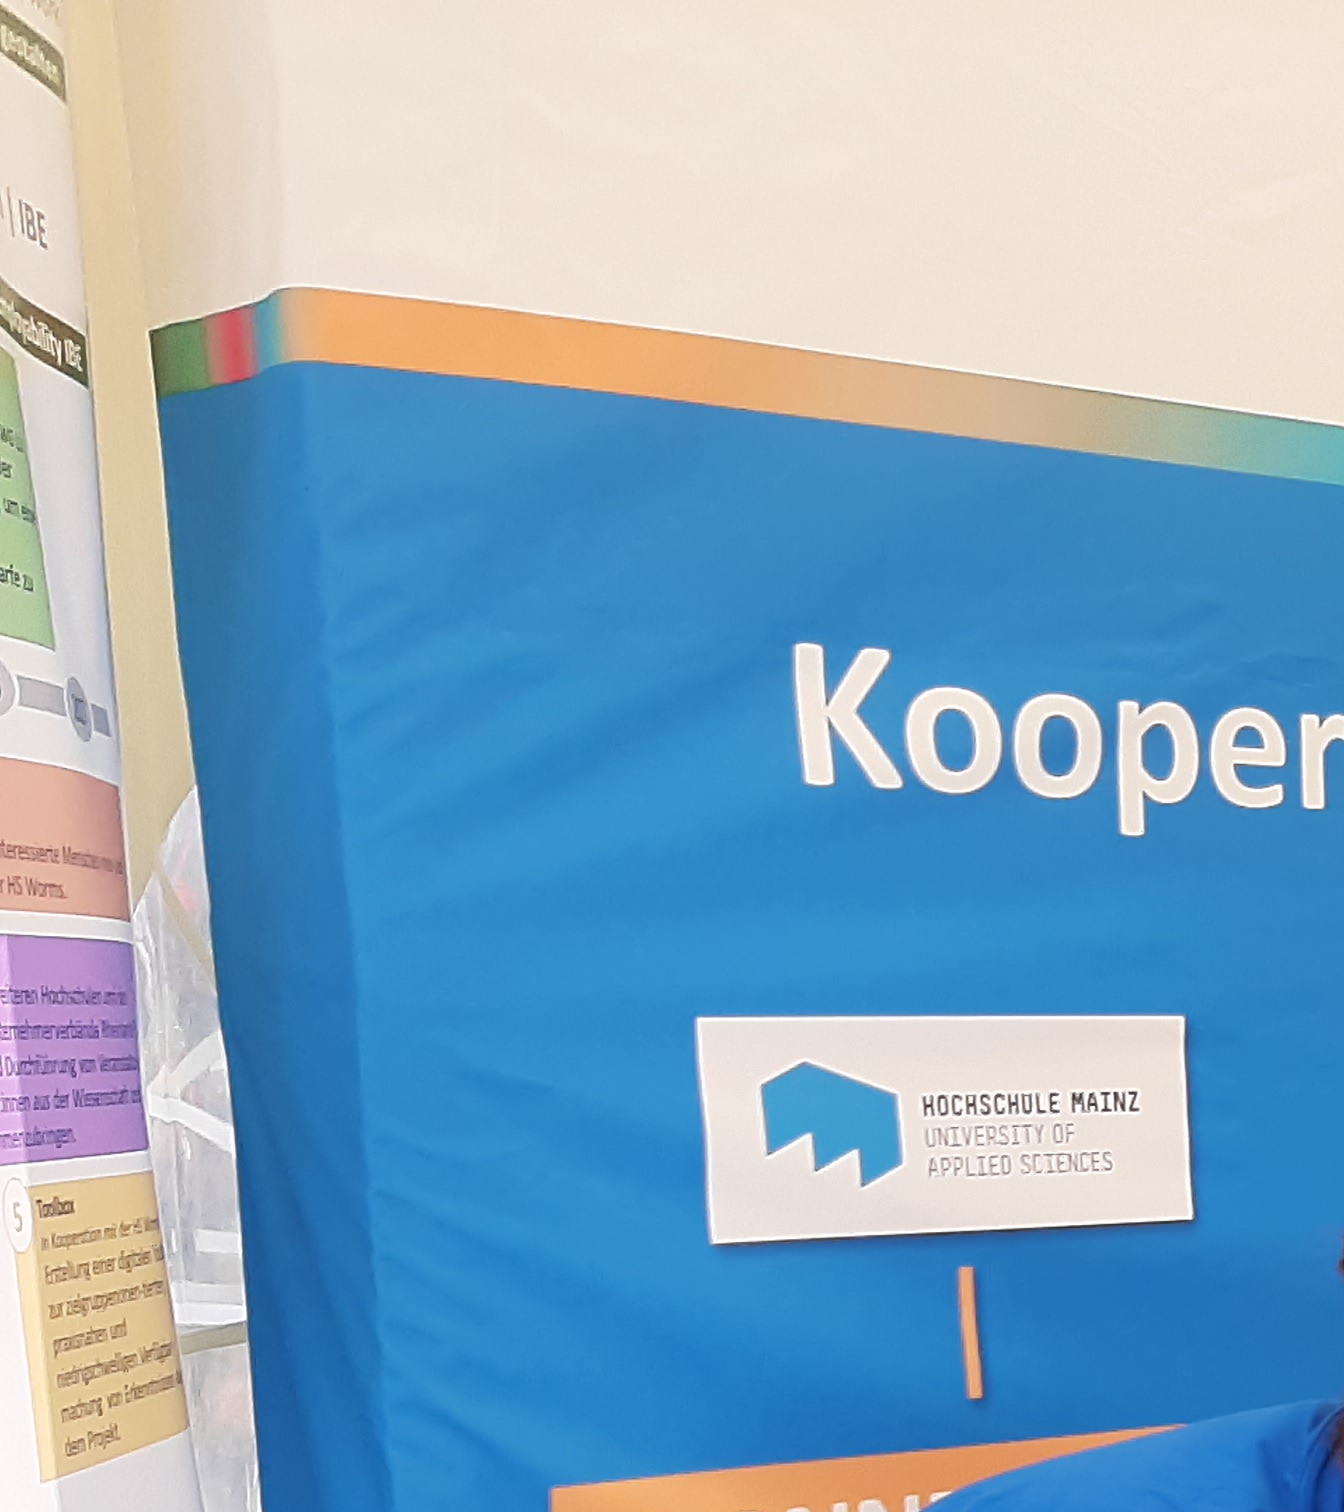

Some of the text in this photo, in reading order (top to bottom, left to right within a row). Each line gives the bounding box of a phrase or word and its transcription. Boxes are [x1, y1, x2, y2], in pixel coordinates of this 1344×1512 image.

[19, 199, 49, 250] IBE
[922, 1090, 1141, 1117] HOCHSCHULE MAINZ
[924, 1122, 1076, 1149] UNIVERSITY OF
[927, 1151, 1115, 1178] APPLIED SCIENCES
[12, 1200, 24, 1234] 5
